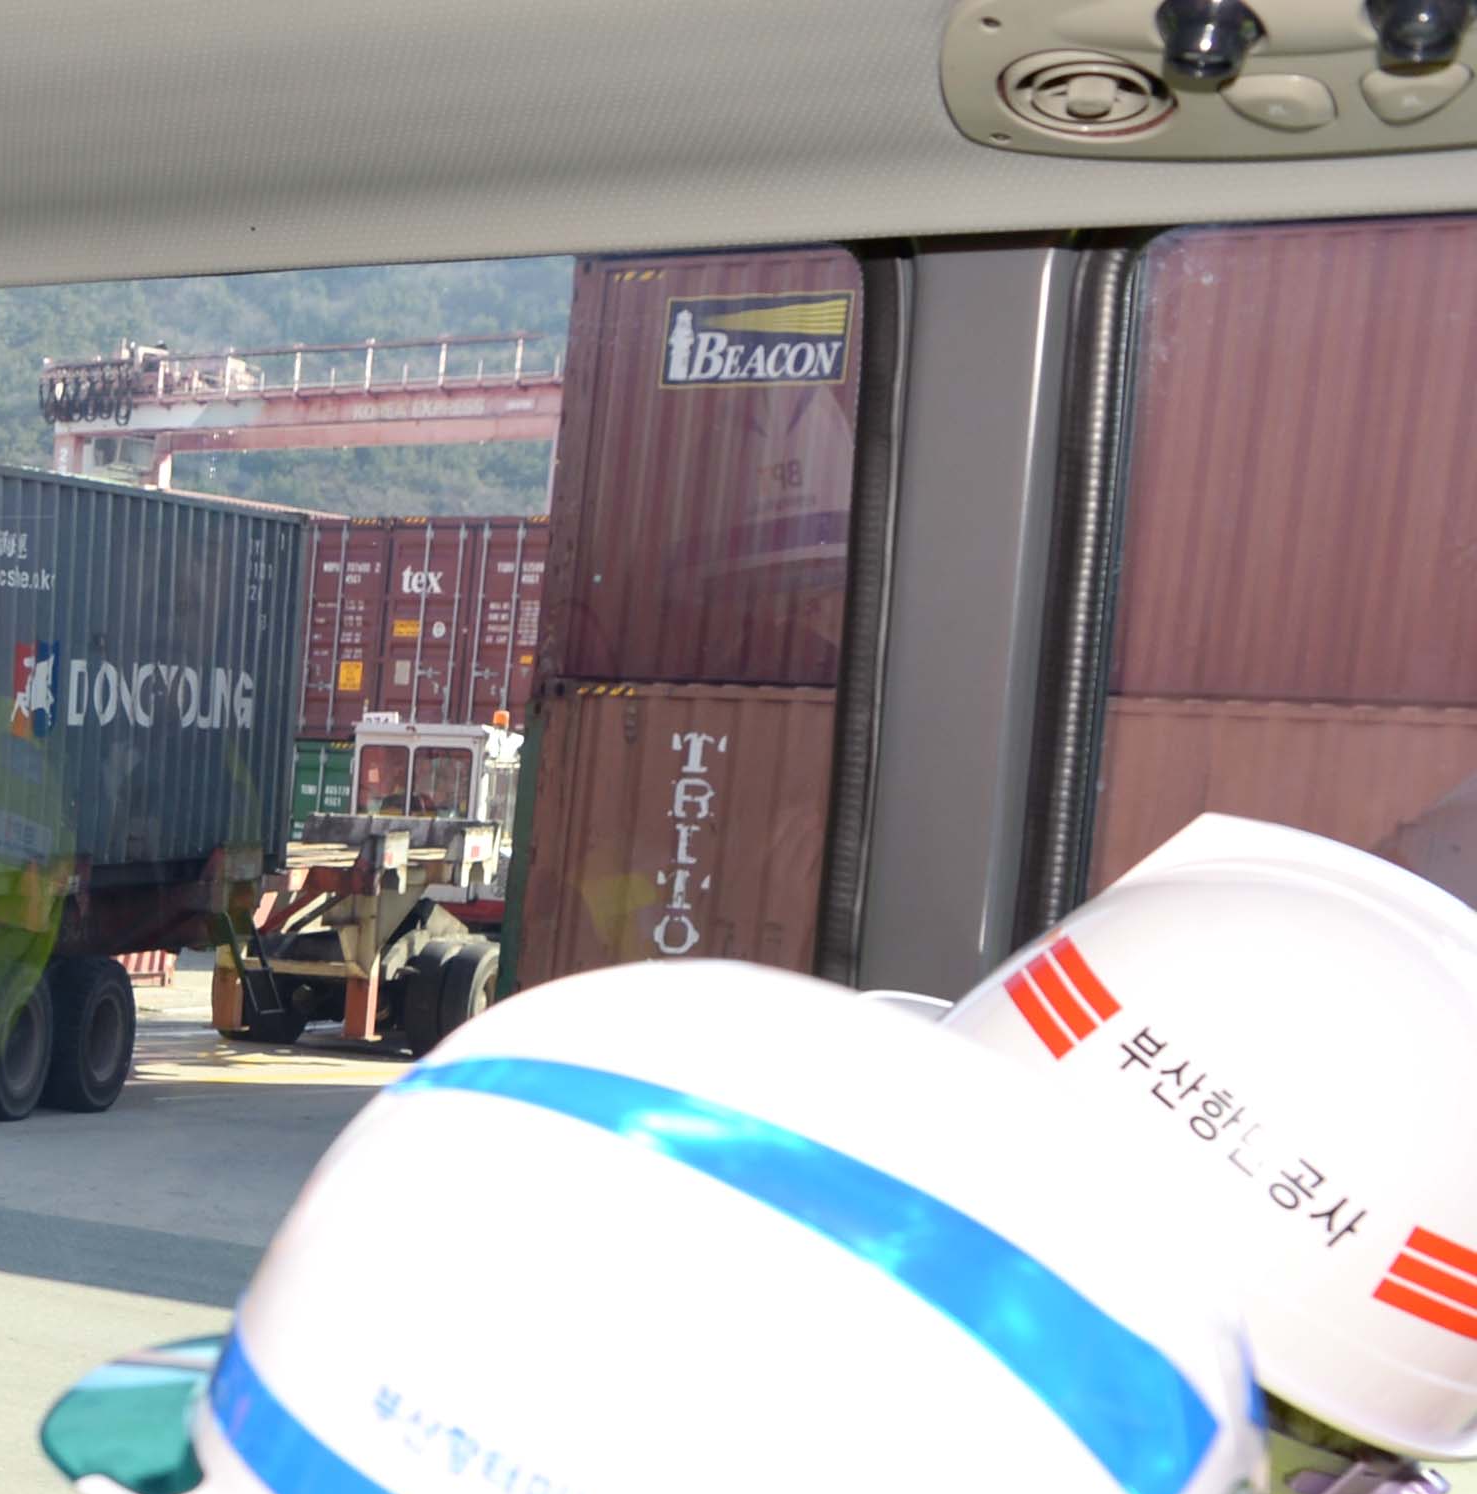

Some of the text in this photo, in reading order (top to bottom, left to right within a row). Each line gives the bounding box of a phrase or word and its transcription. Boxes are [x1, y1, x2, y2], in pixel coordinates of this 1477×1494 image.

[689, 332, 842, 380] BEACON
[352, 402, 407, 420] KOEA
[401, 565, 444, 594] tex
[653, 732, 728, 964] TRITO
